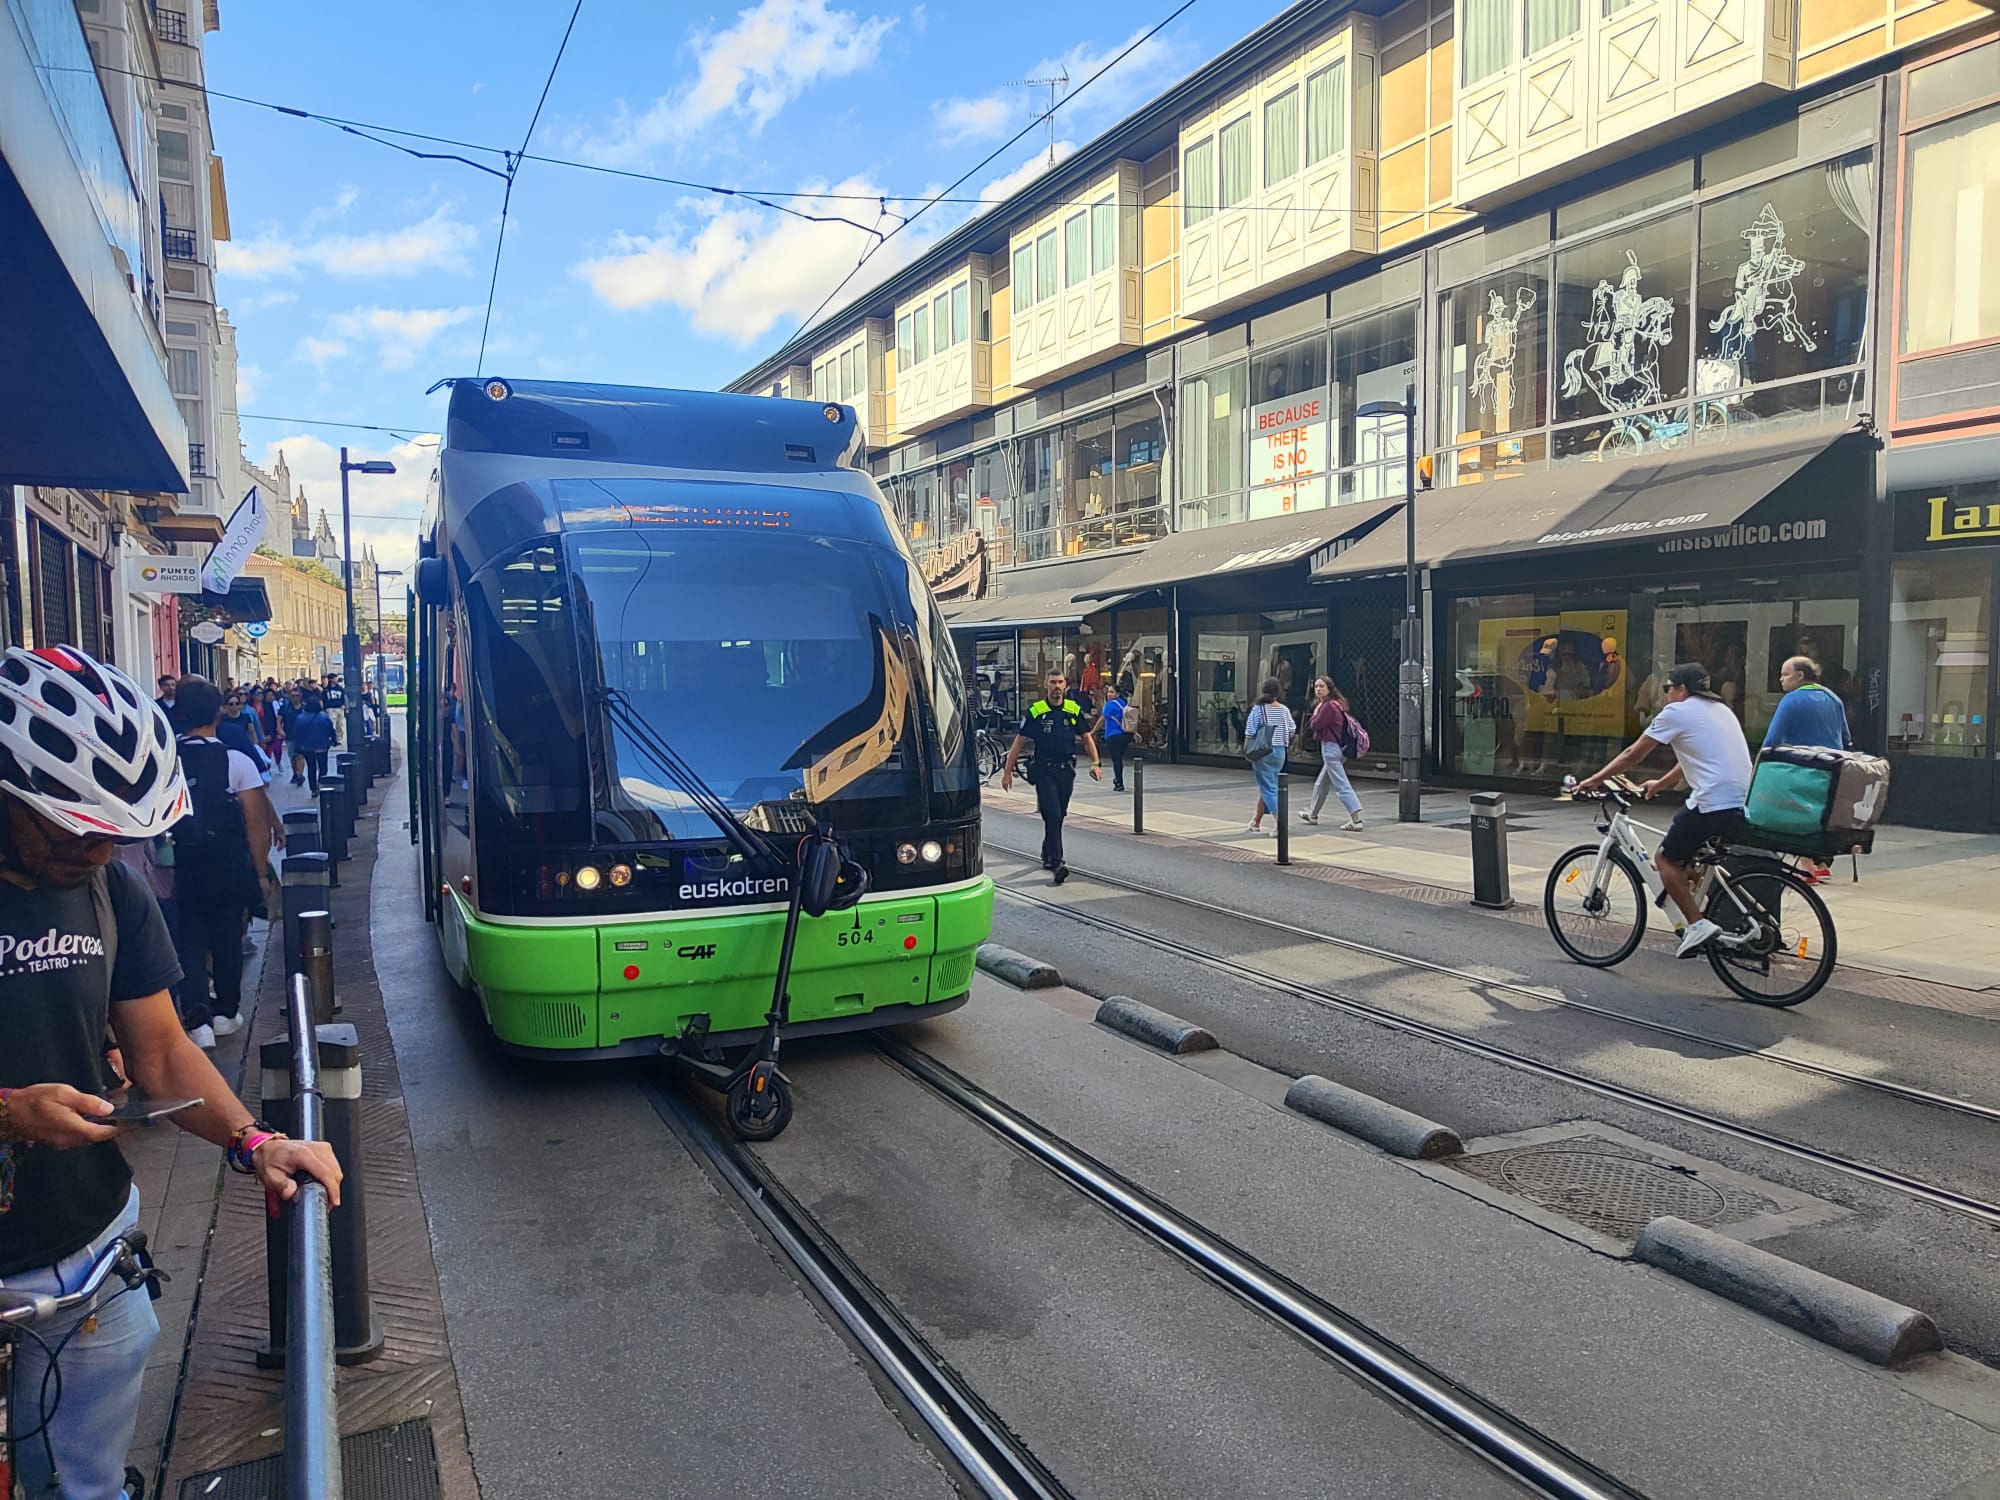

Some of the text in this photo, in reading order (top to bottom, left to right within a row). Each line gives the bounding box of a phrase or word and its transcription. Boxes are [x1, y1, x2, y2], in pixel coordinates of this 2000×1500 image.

[1259, 400, 1320, 430] BECAUSE
[1266, 426, 1308, 449] THERE
[1273, 449, 1307, 470] IS NO
[160, 567, 196, 575] PUNTO
[679, 875, 789, 900] euskotren
[837, 930, 874, 947] 504
[677, 943, 717, 961] CAF
[28, 957, 69, 973] TEATRO
